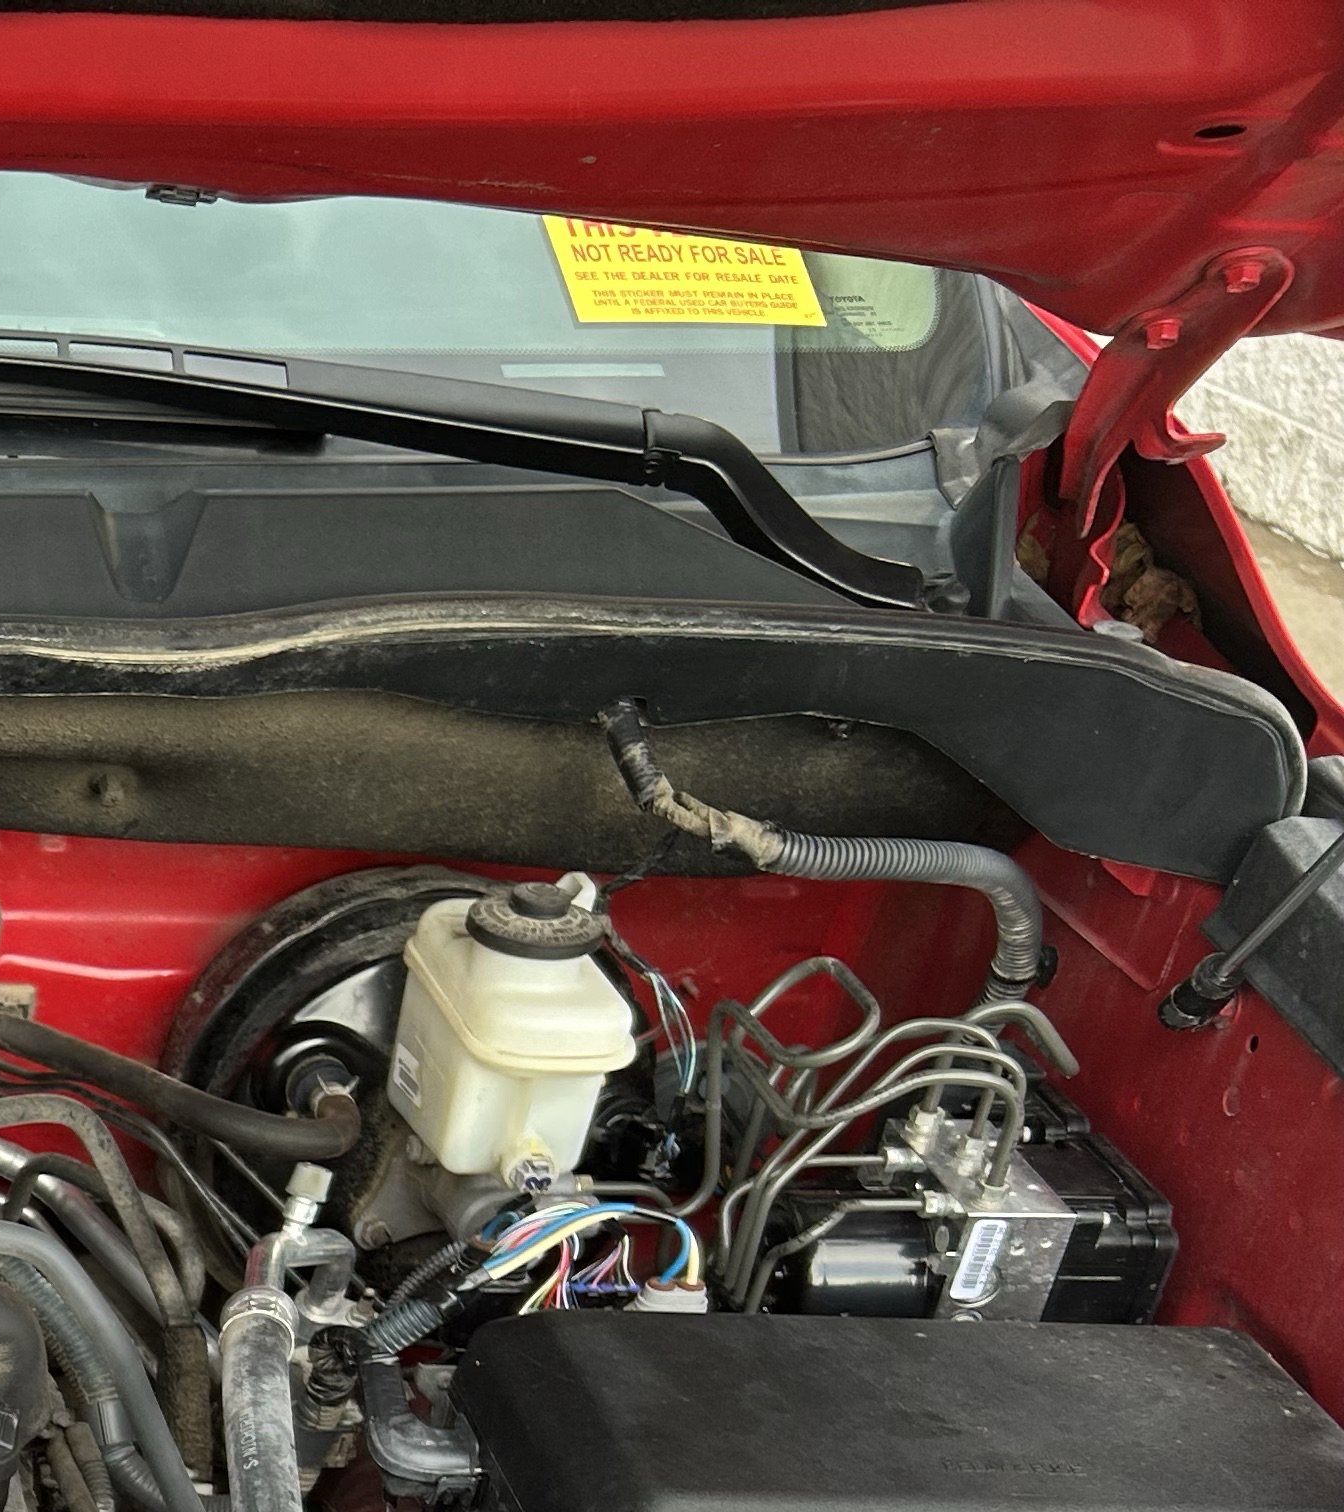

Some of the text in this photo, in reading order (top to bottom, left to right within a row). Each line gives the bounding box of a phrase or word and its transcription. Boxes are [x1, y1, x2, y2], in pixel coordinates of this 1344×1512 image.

[571, 244, 786, 266] NOT READY FOR SALE
[575, 271, 799, 285] SEE THE DEALER FOR RESALE DATE
[620, 290, 664, 298] STICKER
[668, 290, 698, 298] MUST
[703, 291, 744, 299] REMAIN
[829, 295, 865, 303] TOYOTA
